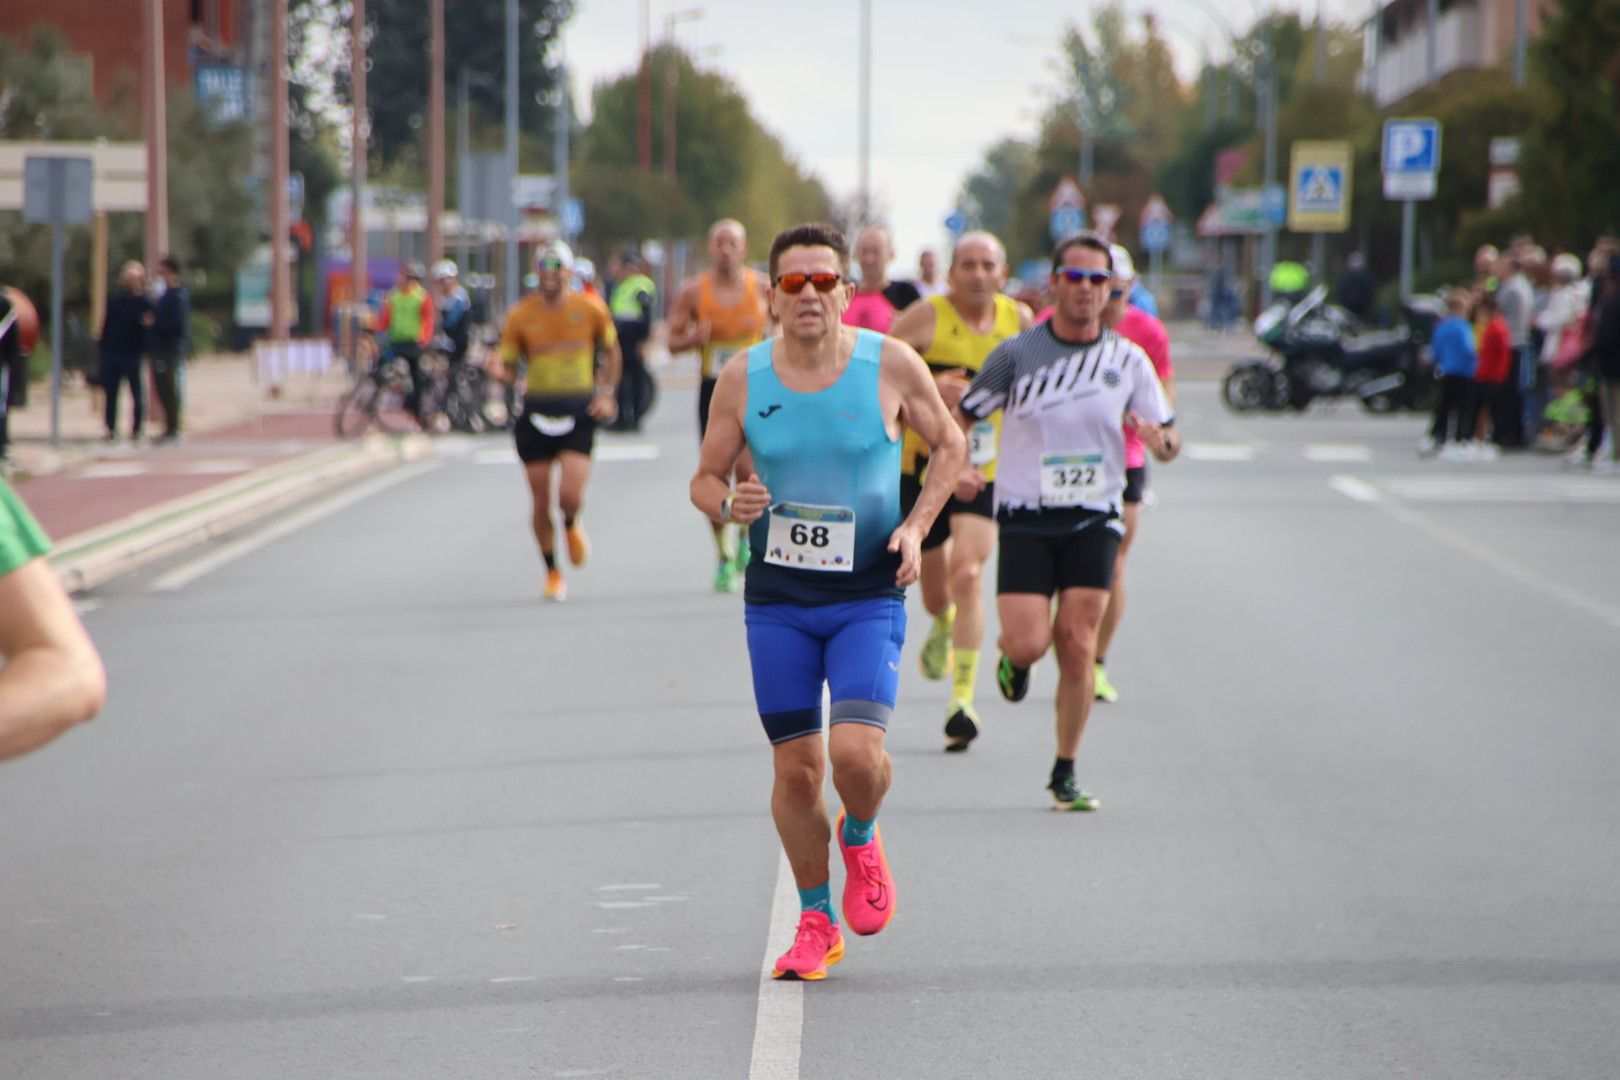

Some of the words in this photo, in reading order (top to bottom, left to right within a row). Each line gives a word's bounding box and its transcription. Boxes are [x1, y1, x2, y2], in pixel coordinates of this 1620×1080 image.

[1389, 124, 1426, 171] P
[1053, 467, 1097, 488] 322
[790, 523, 830, 548] 68
